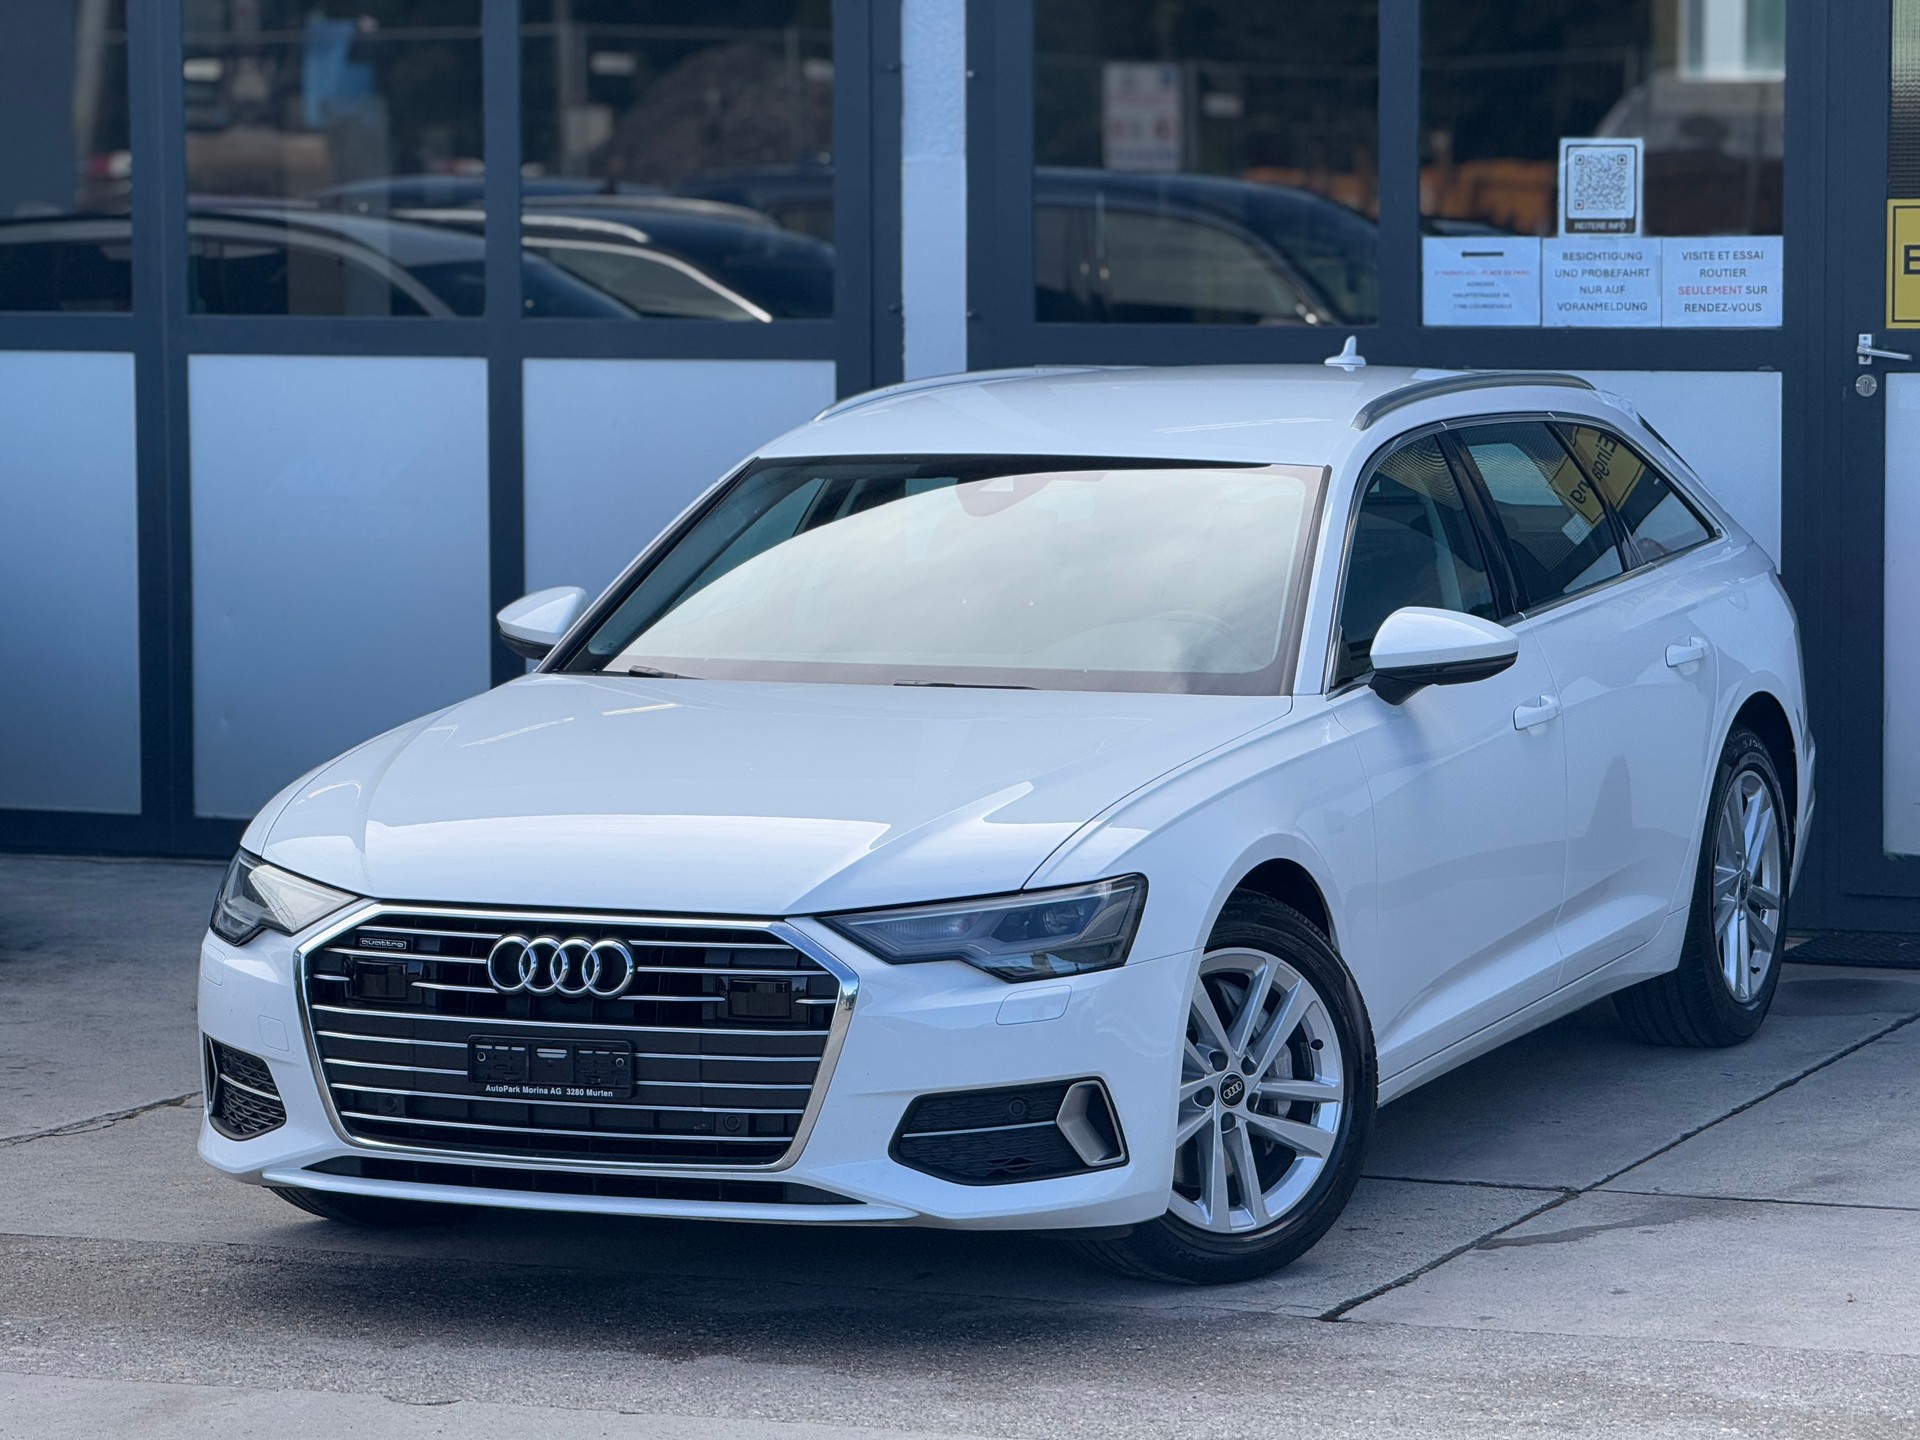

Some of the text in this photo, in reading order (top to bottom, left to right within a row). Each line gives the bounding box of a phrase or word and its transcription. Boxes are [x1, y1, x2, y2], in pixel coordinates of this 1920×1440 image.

[1608, 221, 1627, 231] INFO
[1562, 251, 1643, 261] BESICHTIGUNG
[1682, 250, 1764, 261] VISITE ET ESSAI
[1554, 268, 1650, 278] UND PROBEFAHRT
[1699, 268, 1746, 278] ROUTIER
[1579, 285, 1626, 295] NUR AUF
[1678, 285, 1768, 295] SEULEMENT SUR
[1556, 302, 1648, 312] VORANMELDUNG
[1684, 302, 1762, 312] RENDEZ-VOUS
[361, 939, 404, 948] quattro
[485, 1084, 613, 1098] AutoPark Morina AG 3280 Murten
